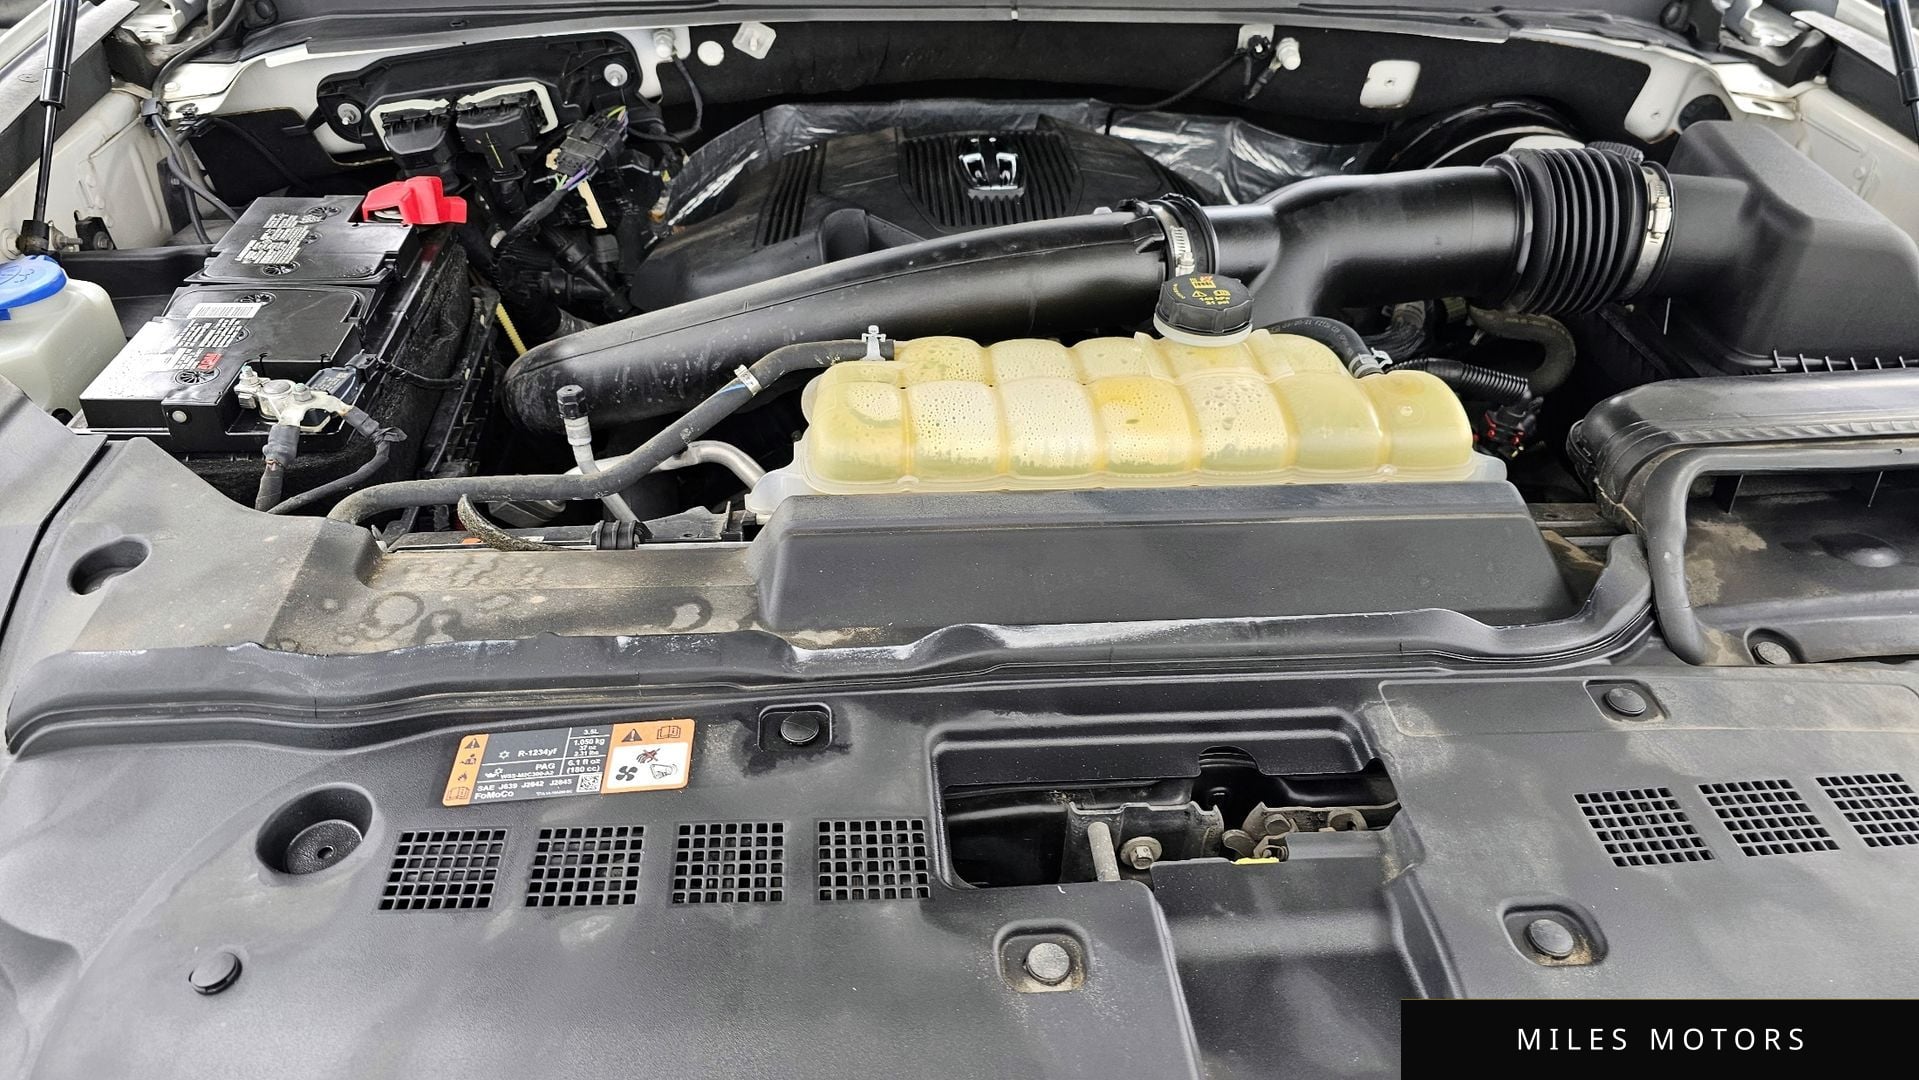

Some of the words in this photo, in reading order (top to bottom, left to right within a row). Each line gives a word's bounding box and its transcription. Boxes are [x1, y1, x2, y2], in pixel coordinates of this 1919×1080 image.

[573, 738, 594, 746] 1.050
[517, 747, 558, 758] R-1234yf
[535, 763, 556, 771] PAG
[566, 766, 585, 774] (180
[476, 784, 495, 792] SAE
[474, 791, 514, 800] FoMoCo
